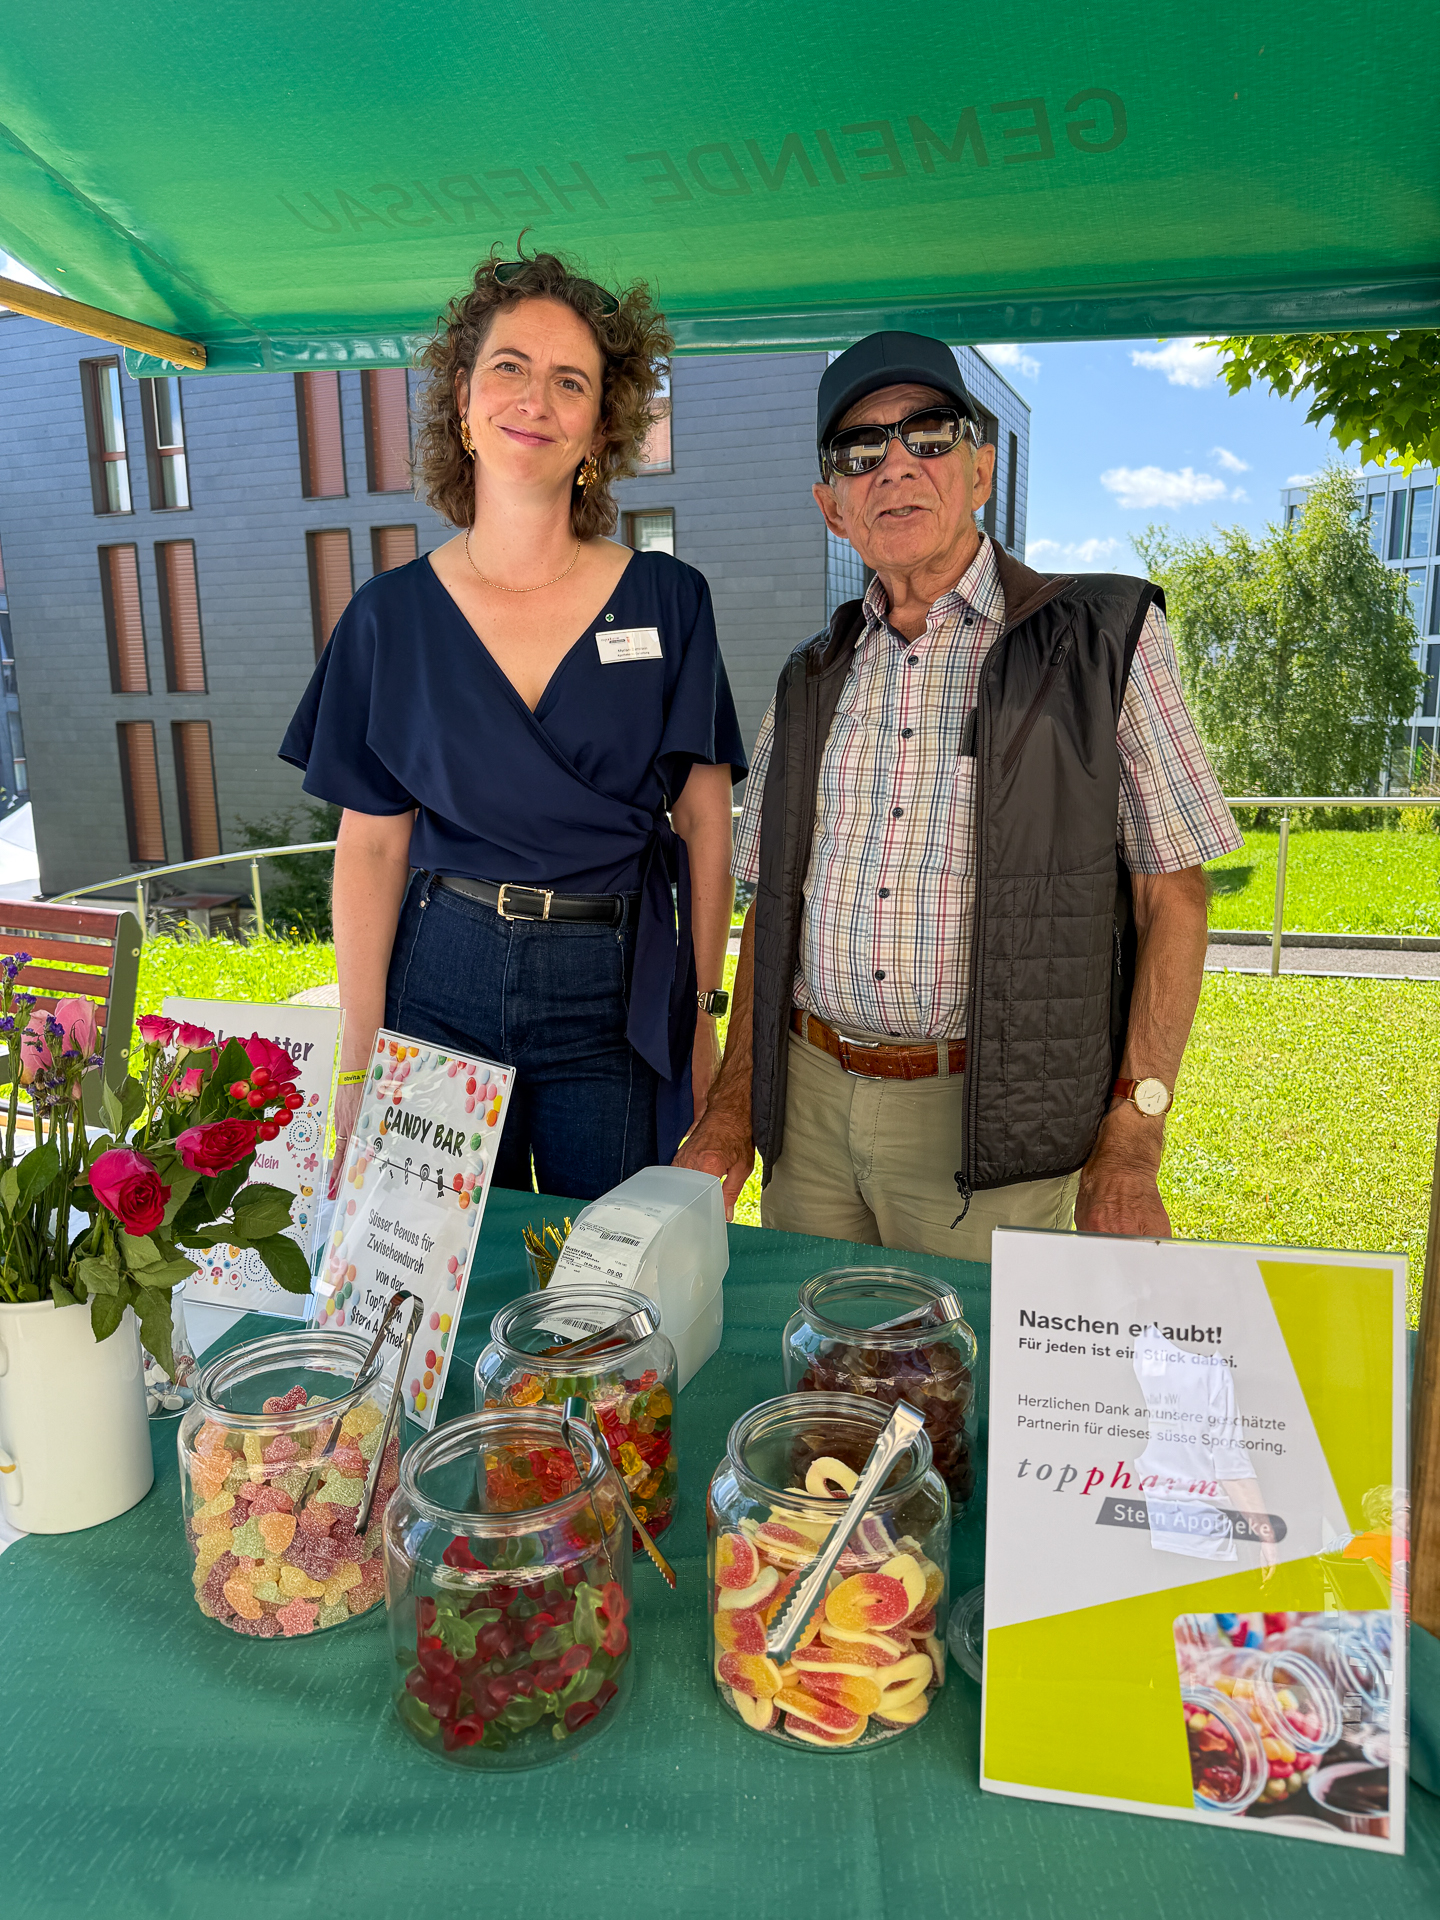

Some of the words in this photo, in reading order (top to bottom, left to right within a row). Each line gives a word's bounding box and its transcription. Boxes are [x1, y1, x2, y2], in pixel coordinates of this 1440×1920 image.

[384, 1106, 433, 1144] CANDY
[432, 1124, 466, 1158] BAR
[368, 1208, 393, 1233] Süsser
[394, 1220, 420, 1247] Genuss
[421, 1233, 435, 1253] für
[367, 1233, 424, 1275] Zwischendurch
[376, 1269, 390, 1286] von
[390, 1275, 405, 1292] der
[350, 1305, 371, 1331] Stern
[1019, 1309, 1119, 1336] Naschen
[1128, 1321, 1222, 1345] erlaubt!
[1018, 1337, 1042, 1350] Für
[1045, 1339, 1086, 1354] jeden
[1091, 1343, 1111, 1357] ist
[1115, 1346, 1138, 1359] ein
[1143, 1348, 1186, 1364] Stück
[1191, 1353, 1238, 1369] dabei.
[1017, 1393, 1090, 1412] Herzlichen
[1095, 1401, 1130, 1416] Dank
[1134, 1407, 1151, 1418] an
[1155, 1409, 1203, 1423] unsere
[1017, 1415, 1080, 1433] Partnerin
[1084, 1421, 1103, 1435] für
[1107, 1425, 1152, 1440] dieses
[1157, 1430, 1197, 1444] süsse
[1201, 1432, 1287, 1456] Sponsoring.
[1017, 1458, 1219, 1497] toppharm
[1113, 1503, 1167, 1526] Stern
[1172, 1512, 1271, 1537] Apotheke
